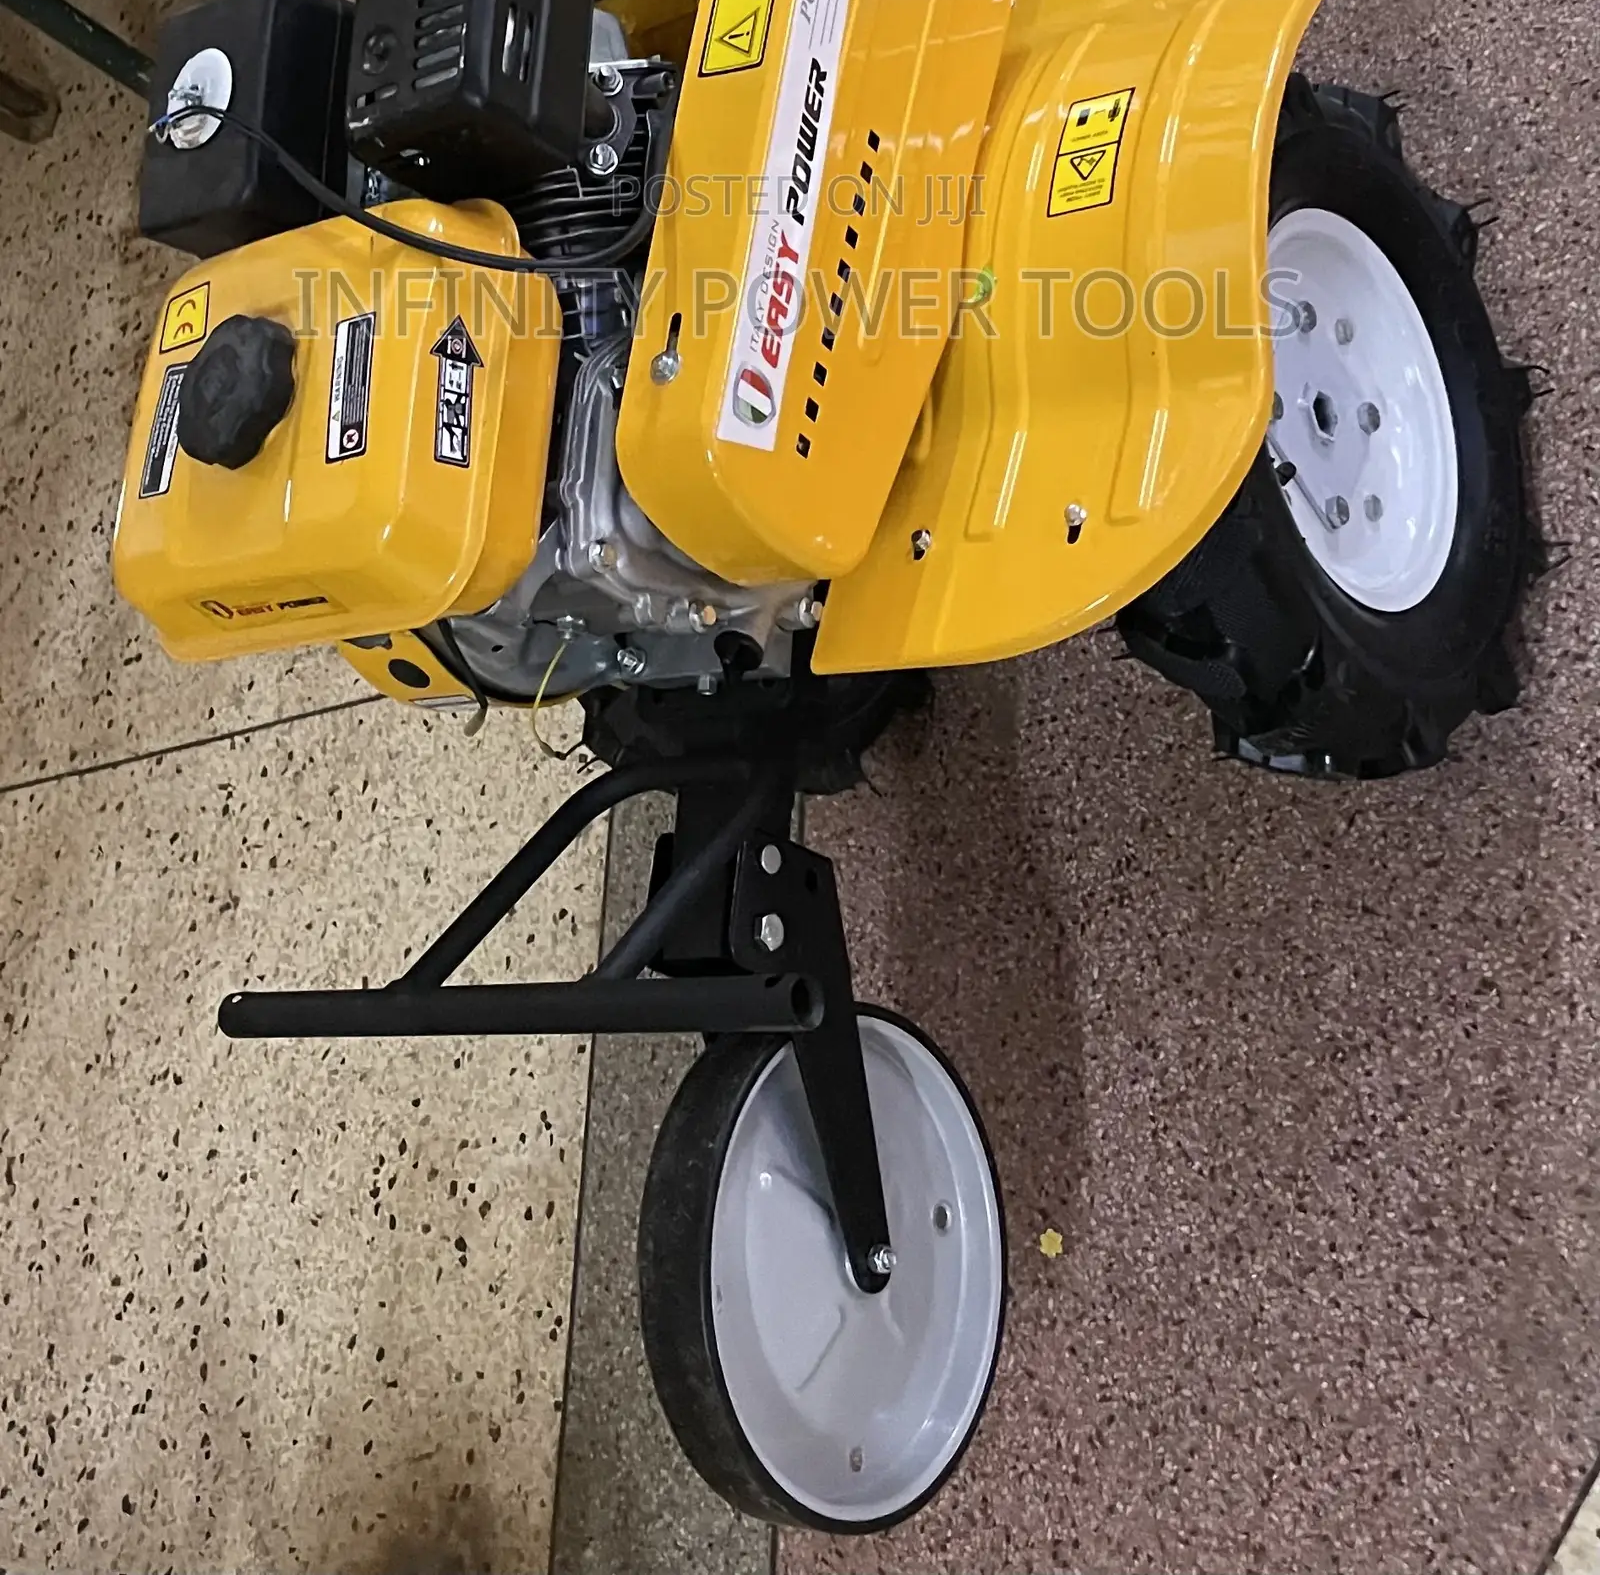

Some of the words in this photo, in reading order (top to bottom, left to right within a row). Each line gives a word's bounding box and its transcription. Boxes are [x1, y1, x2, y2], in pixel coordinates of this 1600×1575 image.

[761, 229, 799, 369] EASY
[786, 57, 828, 226] POWER
[749, 300, 765, 353] ITALY
[760, 219, 780, 295] DESIGN
[333, 355, 344, 402] WARNING
